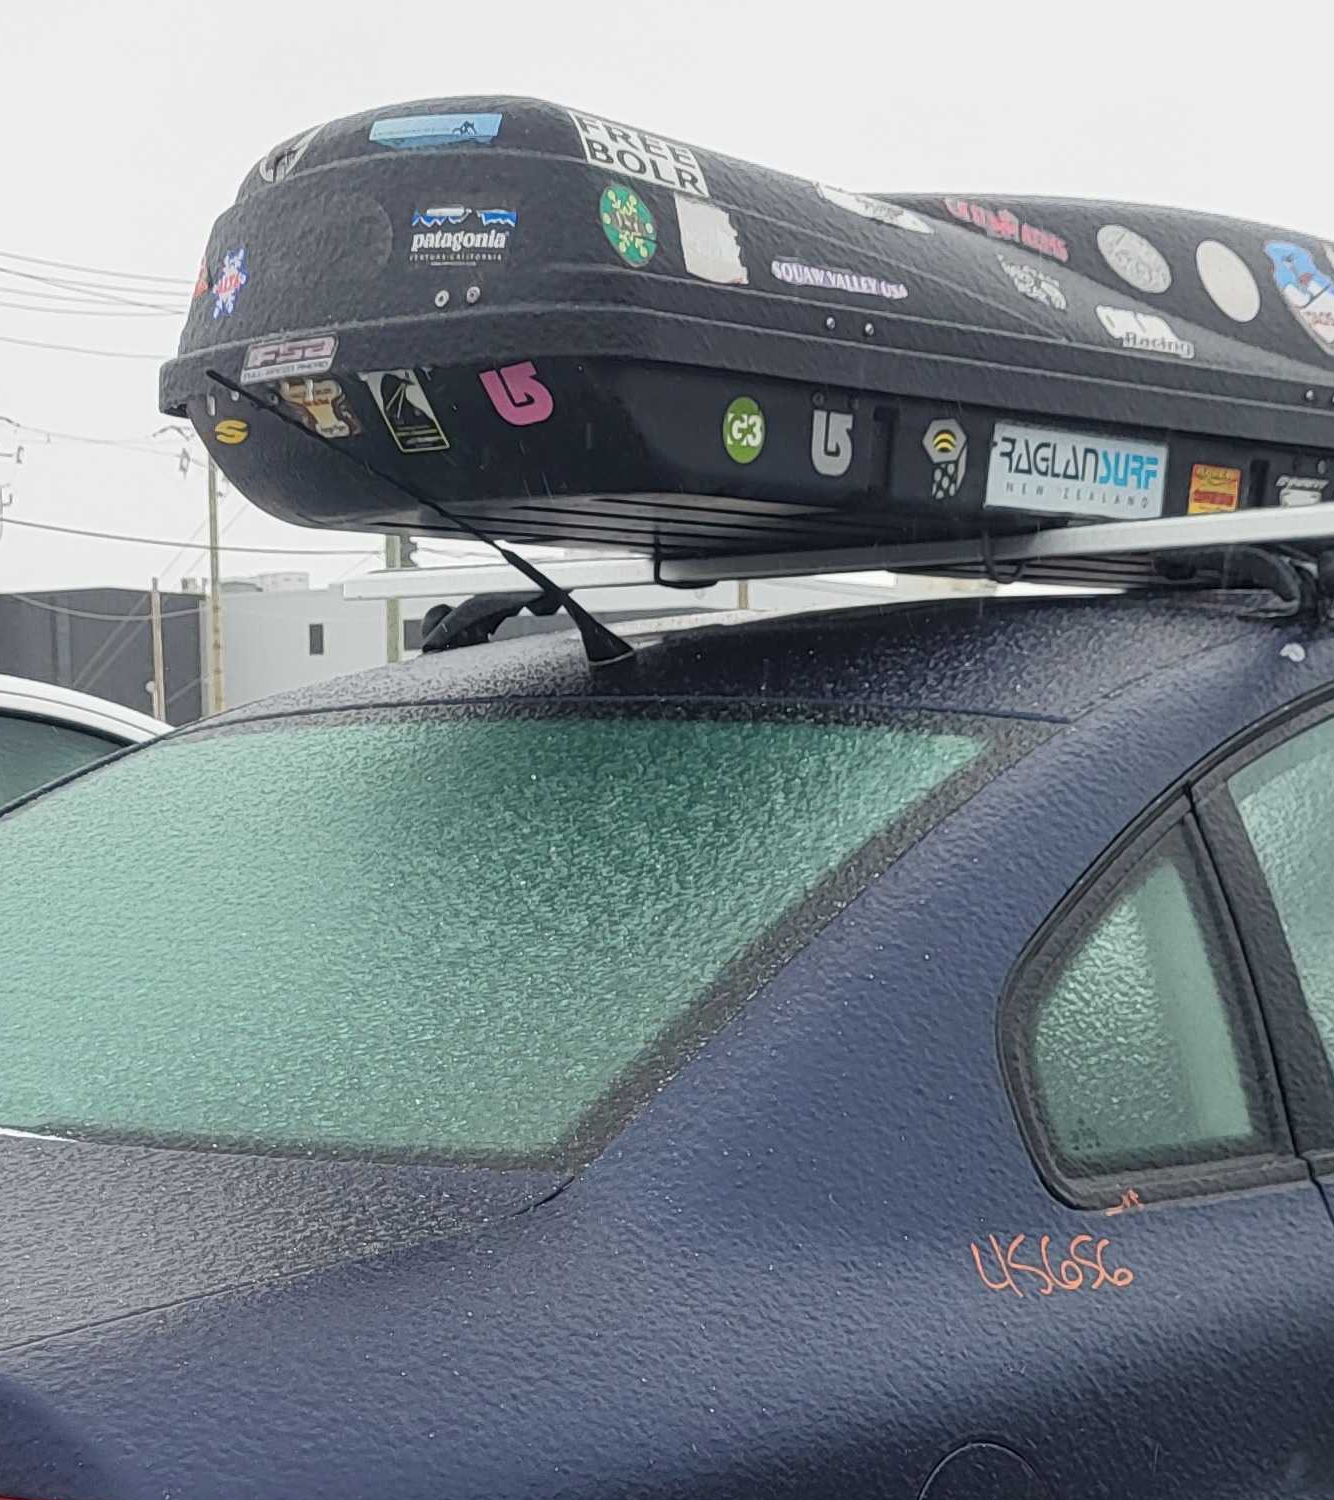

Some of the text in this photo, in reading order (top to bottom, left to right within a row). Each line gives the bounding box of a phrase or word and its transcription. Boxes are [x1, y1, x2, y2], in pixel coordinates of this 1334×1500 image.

[574, 114, 696, 169] FREE
[585, 138, 708, 196] BOLR
[410, 229, 507, 252] patagonia
[825, 270, 878, 296] VALLEY
[1123, 331, 1195, 359] Racing
[728, 413, 764, 447] G3
[1005, 481, 1044, 496] NEW
[970, 1233, 1134, 1298] 45656
